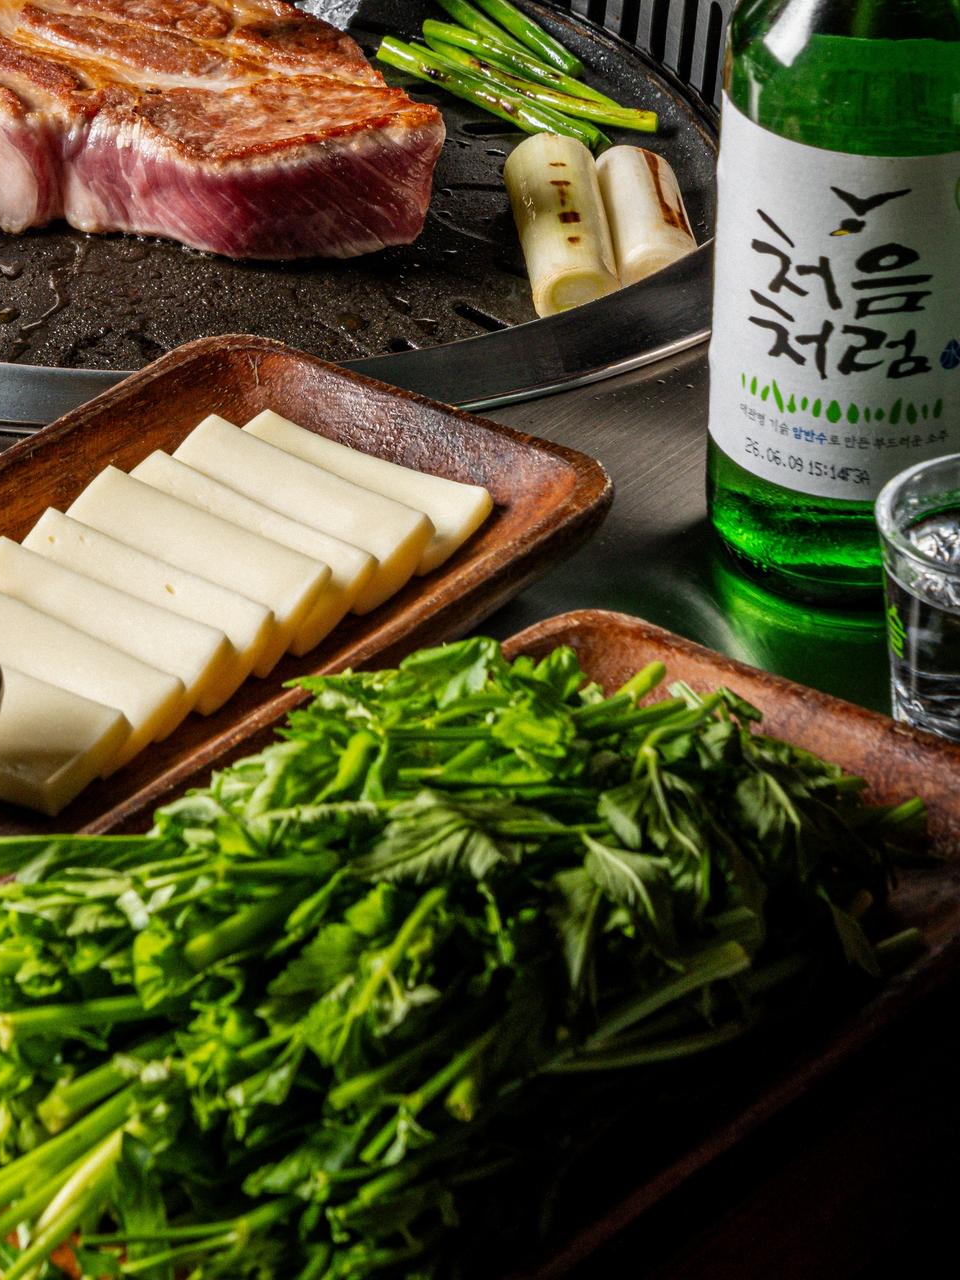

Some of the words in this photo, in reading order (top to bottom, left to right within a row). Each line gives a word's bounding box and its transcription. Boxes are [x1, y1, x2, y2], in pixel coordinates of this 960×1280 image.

[751, 208, 933, 320] 처음
[748, 288, 932, 380] 처럼
[844, 435, 870, 450] 만든
